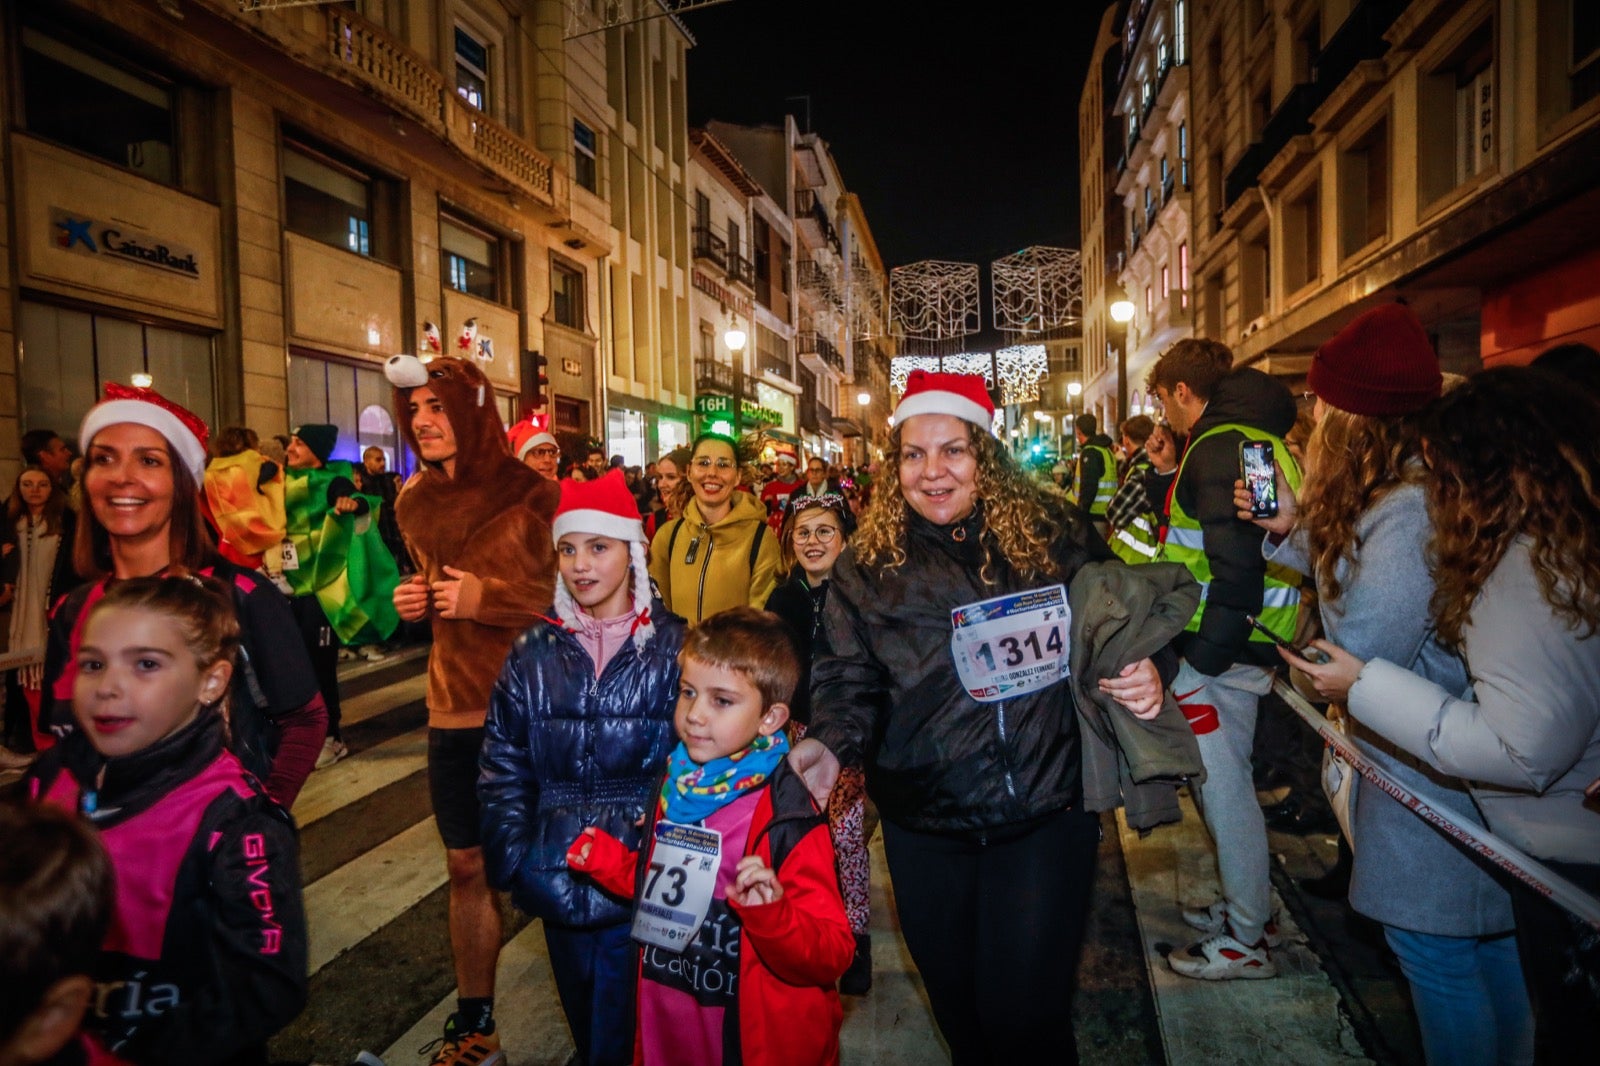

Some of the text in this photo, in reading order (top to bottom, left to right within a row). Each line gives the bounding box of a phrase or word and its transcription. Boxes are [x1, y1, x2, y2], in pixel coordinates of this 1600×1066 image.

[102, 229, 199, 274] CaixaBank
[698, 397, 727, 412] 16H
[975, 626, 1063, 672] 1314
[644, 862, 688, 907] 73
